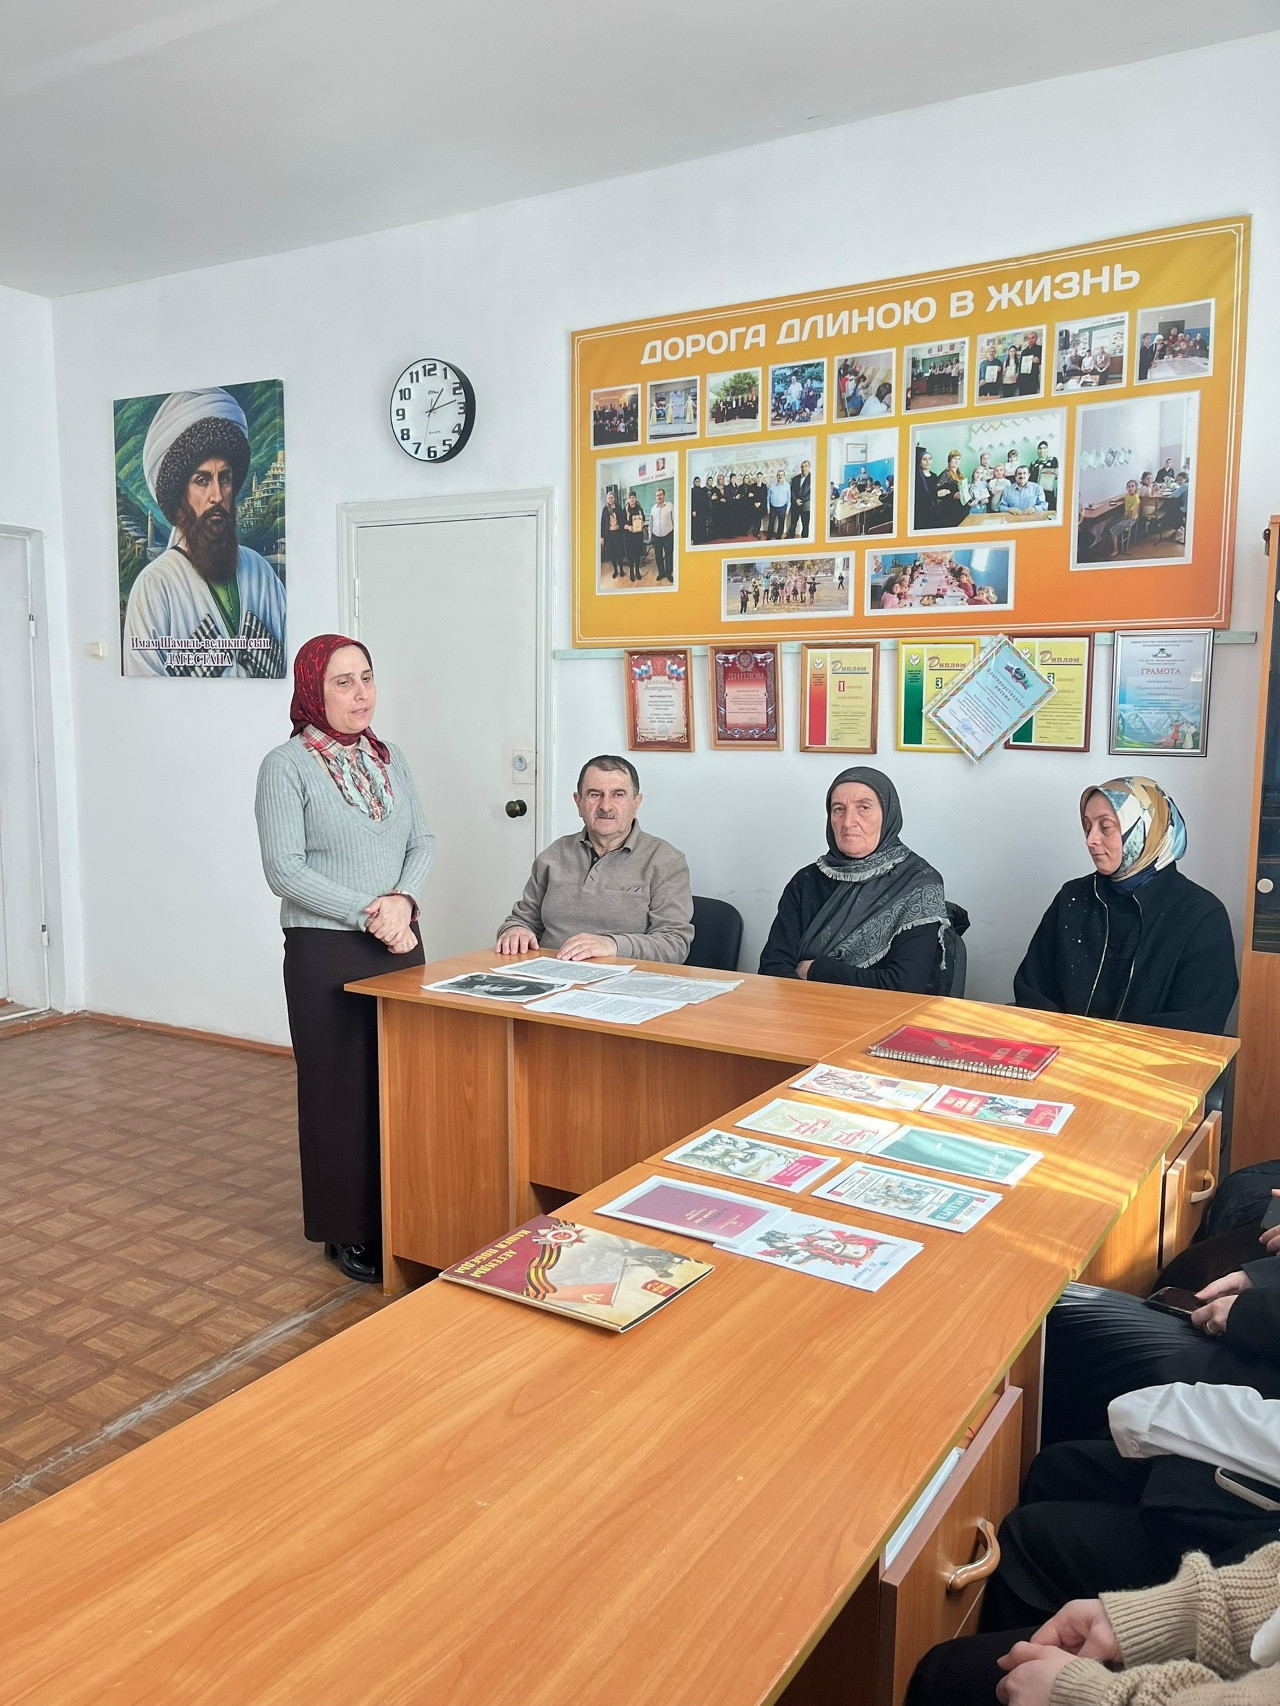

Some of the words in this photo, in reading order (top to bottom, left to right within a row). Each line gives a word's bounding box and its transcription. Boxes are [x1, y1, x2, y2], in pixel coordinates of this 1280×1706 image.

[641, 324, 765, 365] ДОРОГА
[777, 297, 936, 345] ДЛИНОЮ
[950, 290, 975, 318] В
[986, 264, 1140, 312] ЖИЗНЬ
[409, 370, 419, 383] 11
[421, 363, 437, 377] 12
[442, 367, 448, 379] 1
[399, 388, 411, 401] 10
[452, 382, 463, 395] 2
[396, 408, 406, 420] 9
[457, 402, 466, 415] 3
[400, 428, 410, 441] 8
[452, 423, 461, 435] 4
[412, 442, 421, 454] 7
[427, 446, 437, 458] 6
[442, 439, 452, 452] 5
[131, 637, 158, 648] Имам
[248, 638, 270, 649] сын
[166, 653, 231, 667] ДАГЕСТАНА
[728, 672, 764, 681] ДИПЛОМ
[935, 678, 942, 688] 3
[494, 1229, 531, 1249] НАШЕЙ
[454, 1248, 499, 1274] ПОБЕДЫ
[470, 1249, 517, 1278] ЛЕГЕНДЫ
